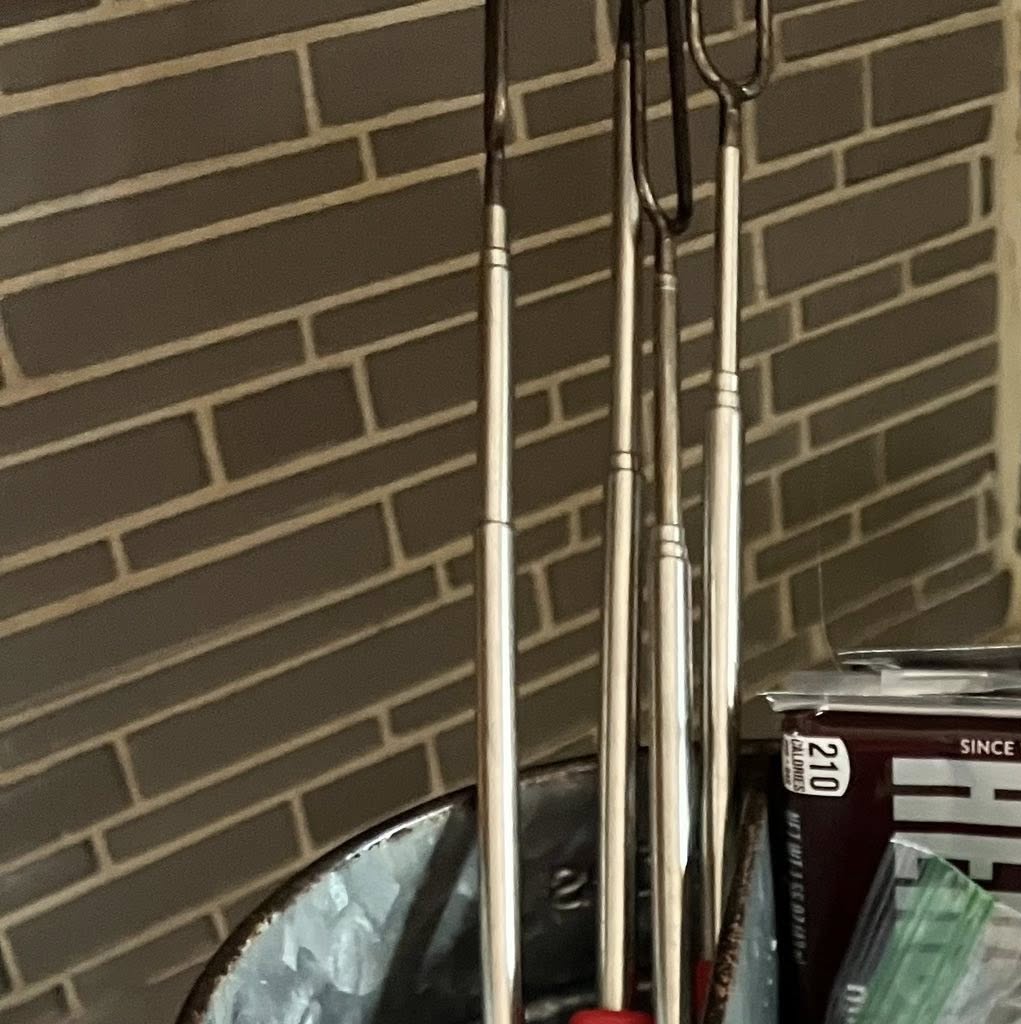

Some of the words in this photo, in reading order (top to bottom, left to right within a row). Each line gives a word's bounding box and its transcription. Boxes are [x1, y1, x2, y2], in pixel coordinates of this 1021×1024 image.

[791, 738, 806, 792] CALORIES
[808, 742, 840, 791] 210
[960, 739, 1015, 756] SINCE
